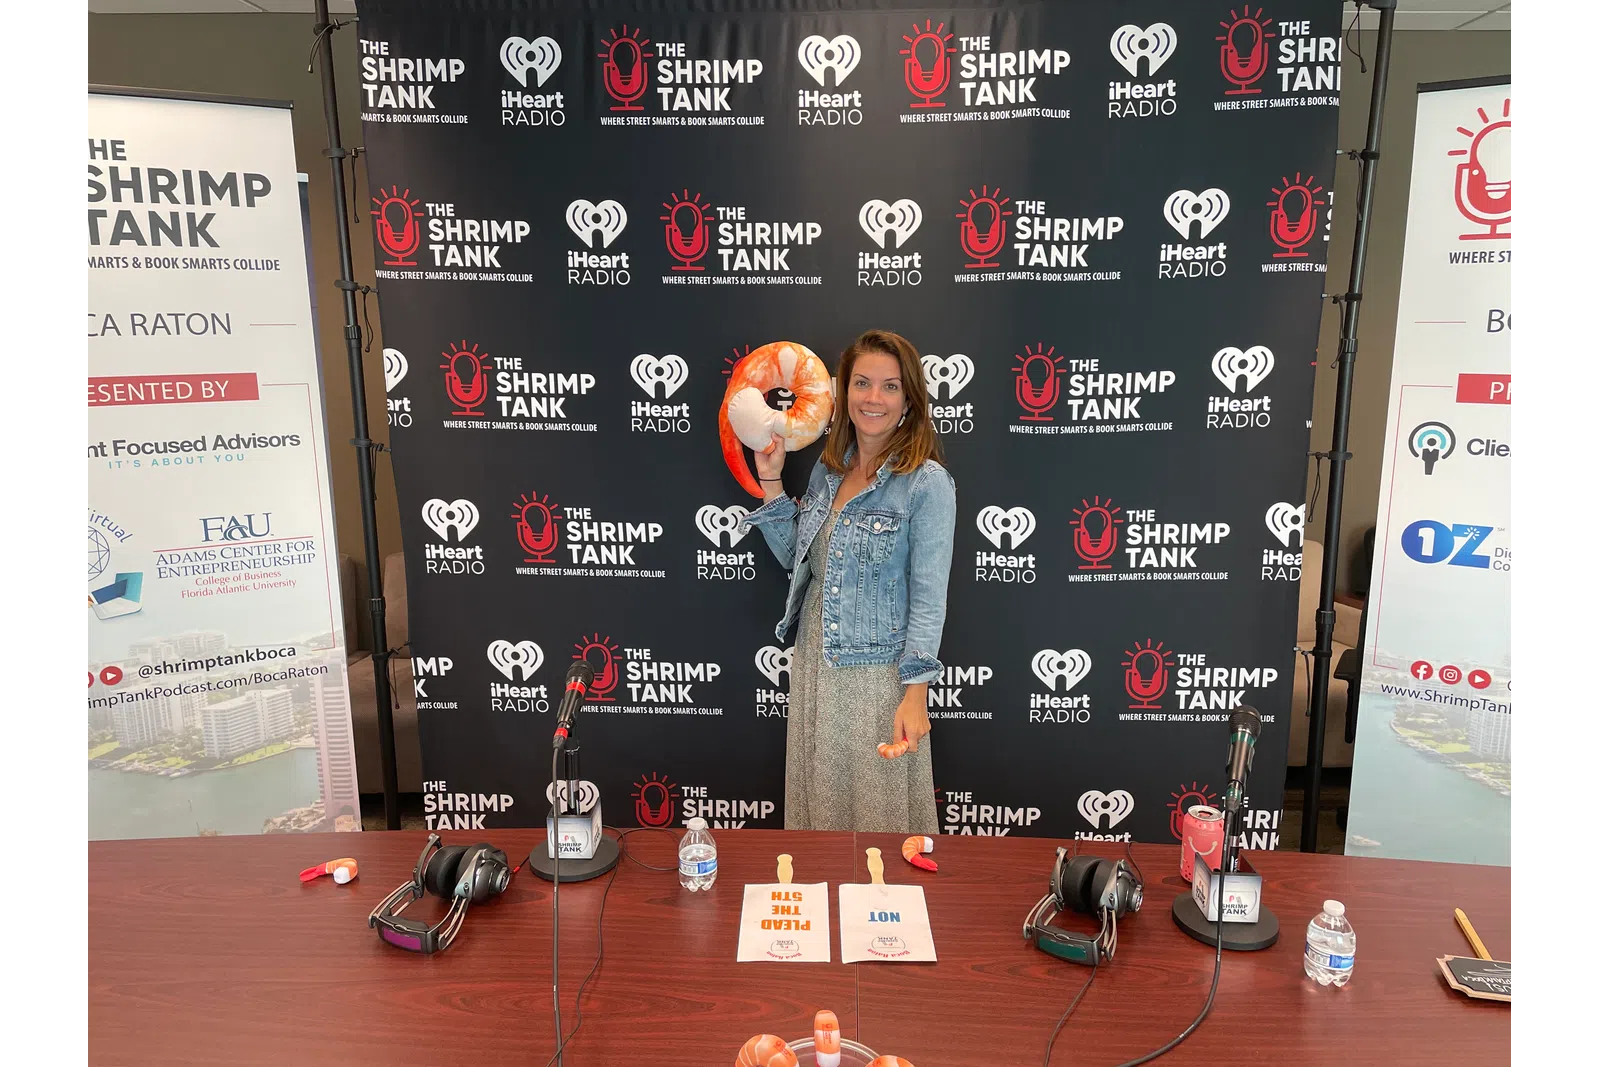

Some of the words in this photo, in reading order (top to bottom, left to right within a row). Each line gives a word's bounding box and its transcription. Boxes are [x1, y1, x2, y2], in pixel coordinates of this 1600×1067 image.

[1278, 20, 1309, 36] THE
[360, 40, 389, 56] THE
[656, 43, 685, 56] THE
[959, 36, 990, 51] THE
[362, 58, 464, 81] SHRIMP
[657, 59, 762, 83] SHRIMP
[960, 49, 1070, 78] SHRIMP
[362, 84, 435, 108] TANK
[657, 87, 731, 110] TANK
[798, 89, 861, 107] iHeart
[959, 77, 1036, 105] TANK
[1109, 80, 1175, 99] iHeart
[501, 90, 563, 108] iHeart
[1108, 98, 1176, 118] RADIO
[502, 110, 564, 125] RADIO
[600, 117, 624, 125] WHERE
[626, 117, 650, 125] STREET
[652, 117, 679, 125] SMARTS
[680, 117, 686, 125] &
[688, 117, 706, 125] BOOK
[708, 116, 735, 125] SMARTS
[736, 116, 764, 125] COLLIDE
[798, 109, 862, 124] RADIO
[88, 164, 271, 207] SHRIMP
[425, 203, 454, 216] THE
[716, 207, 745, 220] THE
[1015, 201, 1044, 214] THE
[428, 218, 530, 242] SHRIMP
[718, 222, 821, 244] SHRIMP
[1015, 216, 1123, 240] SHRIMP
[429, 244, 501, 267] TANK
[568, 250, 628, 268] iHeart
[718, 248, 790, 270] TANK
[858, 252, 921, 268] iHeart
[1014, 243, 1088, 267] TANK
[1160, 242, 1226, 262] iHeart
[1449, 251, 1494, 263] WHERE
[132, 257, 141, 268] &
[144, 257, 179, 268] BOOK
[182, 258, 230, 269] SMARTS
[233, 258, 280, 270] COLLIDE
[1159, 260, 1225, 278] RADIO
[375, 270, 399, 278] WHERE
[400, 271, 423, 279] STREET
[424, 271, 451, 279] SMARTS
[452, 272, 457, 280] &
[459, 272, 477, 280] BOOK
[478, 273, 505, 281] SMARTS
[568, 269, 630, 285] RADIO
[858, 270, 921, 285] RADIO
[130, 313, 231, 335] RATON
[494, 357, 522, 369] THE
[1070, 359, 1098, 371] THE
[201, 380, 228, 398] BY
[496, 371, 595, 394] SHRIMP
[1069, 371, 1175, 396] SHRIMP
[496, 396, 566, 418] TANK
[631, 400, 689, 418] iHeart
[1068, 397, 1140, 420] TANK
[1208, 396, 1270, 414] iHeart
[632, 418, 690, 432] RADIO
[1009, 425, 1032, 433] WHERE
[1034, 426, 1058, 434] STREET
[1060, 425, 1087, 433] SMARTS
[1088, 425, 1094, 433] &
[1116, 423, 1143, 432] SMARTS
[1144, 422, 1172, 430] COLLIDE
[1207, 412, 1270, 428] RADIO
[112, 435, 206, 456] Focused
[212, 433, 300, 450] Advisors
[108, 460, 141, 469] IT'S
[152, 456, 204, 467] ABOUT
[214, 454, 245, 462] YOU
[564, 507, 591, 521] THE
[1126, 509, 1154, 522] THE
[566, 521, 662, 542] SHRIMP
[1126, 523, 1230, 544] SHRIMP
[156, 550, 216, 565] ADAMS
[220, 543, 282, 558] CENTER
[286, 540, 314, 552] FOR
[425, 543, 483, 560] iHeart
[567, 544, 634, 564] TANK
[697, 549, 754, 568] iHeart
[976, 551, 1035, 570] iHeart
[1125, 547, 1196, 567] TANK
[157, 553, 315, 578] ENTREPRENEURSHIP
[426, 560, 484, 574] RADIO
[563, 568, 588, 576] SMARTS
[589, 568, 594, 576] &
[614, 569, 639, 577] SMARTS
[698, 566, 755, 580] RADIO
[195, 575, 230, 587] College
[232, 572, 242, 582] of
[244, 570, 281, 580] Business
[976, 568, 1035, 583] RADIO
[181, 587, 213, 599] Florida
[216, 583, 250, 594] Atlantic
[253, 578, 296, 591] University
[138, 647, 295, 678] @shrimptankboca
[624, 648, 650, 659] THE
[1177, 654, 1205, 665] THE
[626, 661, 720, 681] SHRIMP
[1176, 668, 1277, 687] SHRIMP
[490, 682, 547, 700] iHeart
[627, 683, 693, 702] TANK
[1175, 690, 1245, 709] TANK
[492, 698, 548, 712] RADIO
[1030, 693, 1090, 710] iHeart
[1030, 710, 1090, 722] RADIO
[423, 780, 446, 792] THE
[682, 786, 707, 799] THE
[424, 793, 513, 812] SHRIMP
[946, 792, 972, 802] THE
[682, 799, 774, 820] SHRIMP
[945, 805, 1040, 826] SHRIMP
[771, 891, 802, 901] 5TH
[772, 905, 801, 915] THE
[868, 912, 900, 922] NOT
[761, 919, 810, 930] PLEAD
